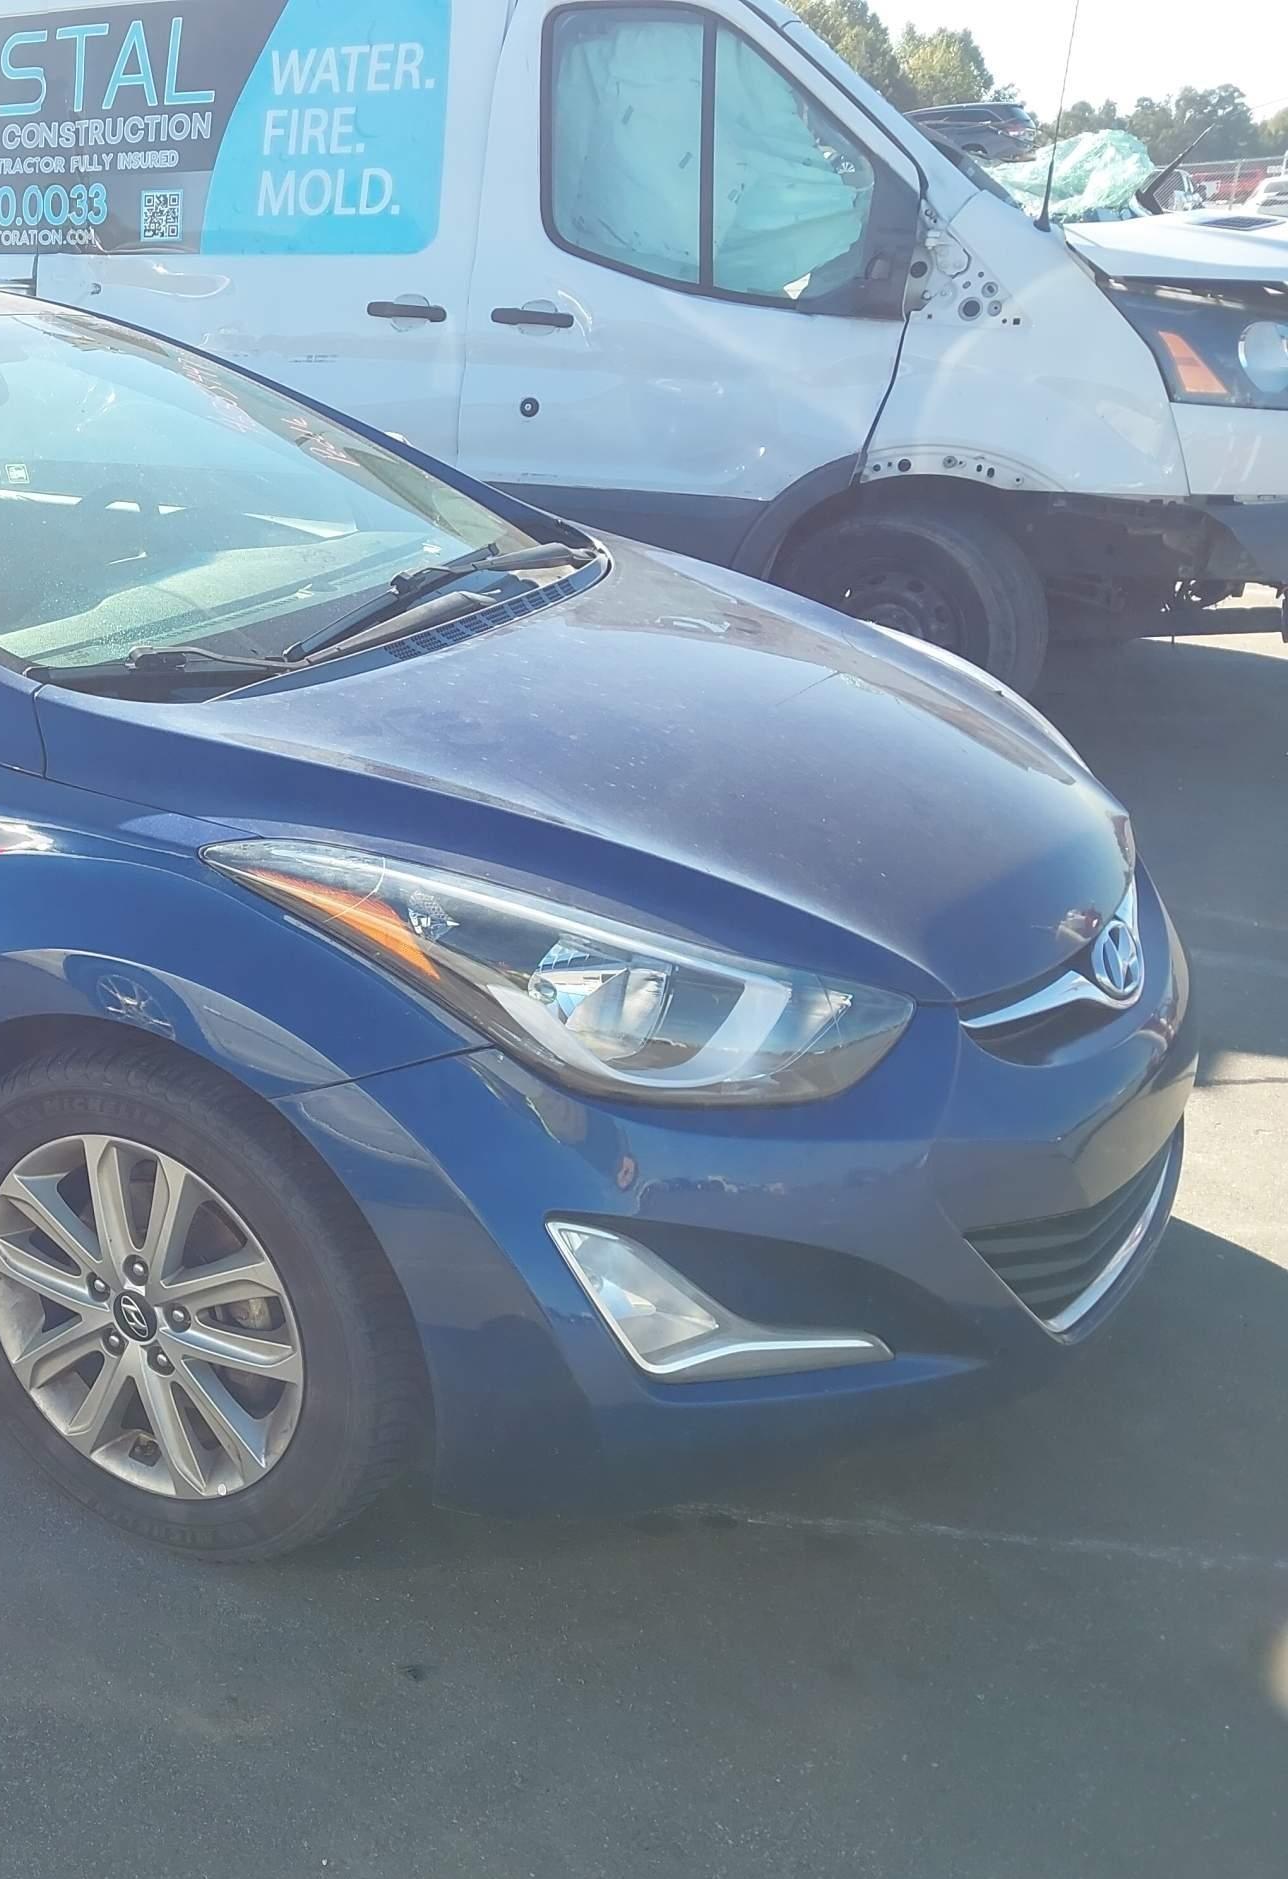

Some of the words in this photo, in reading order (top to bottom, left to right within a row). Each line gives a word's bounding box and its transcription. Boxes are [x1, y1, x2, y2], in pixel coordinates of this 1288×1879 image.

[271, 42, 435, 95] WATER.
[2, 112, 212, 149] CONSTRUCTION
[263, 106, 365, 156] FIRE.
[70, 153, 114, 173] FULLY
[117, 149, 179, 170] INSURED
[257, 167, 400, 216] MOLD.
